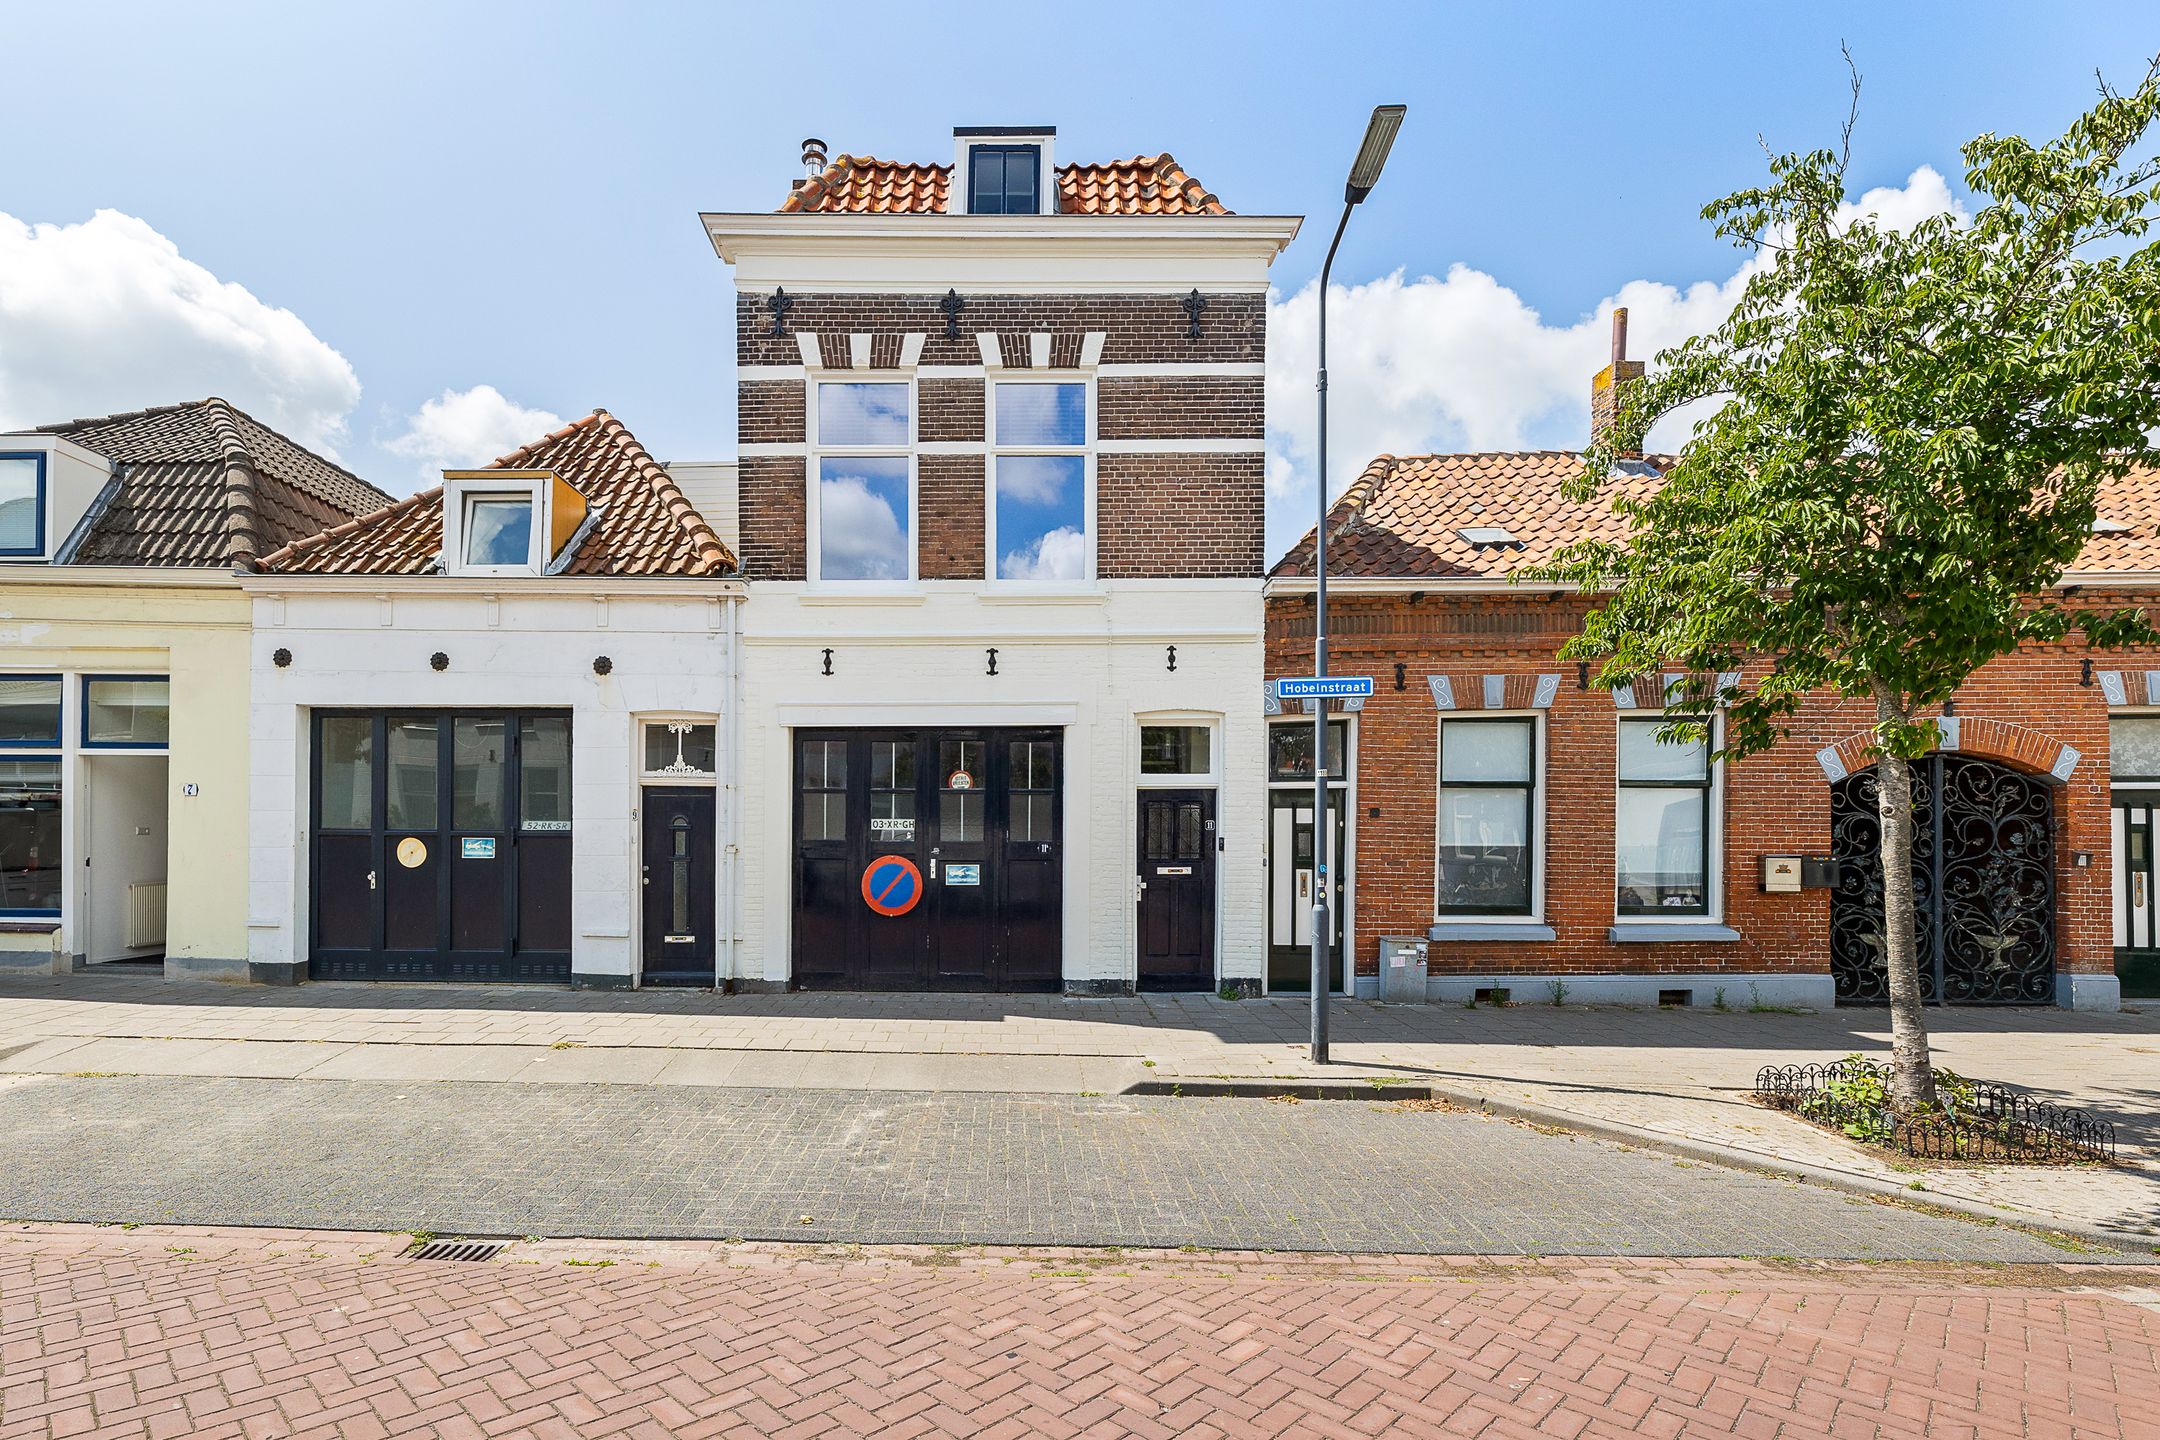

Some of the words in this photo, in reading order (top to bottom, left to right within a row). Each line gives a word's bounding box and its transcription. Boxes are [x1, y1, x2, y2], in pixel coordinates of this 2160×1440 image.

[187, 784, 193, 795] 7
[527, 821, 568, 830] 52-RK-SR
[872, 820, 915, 829] 03-XR-GH
